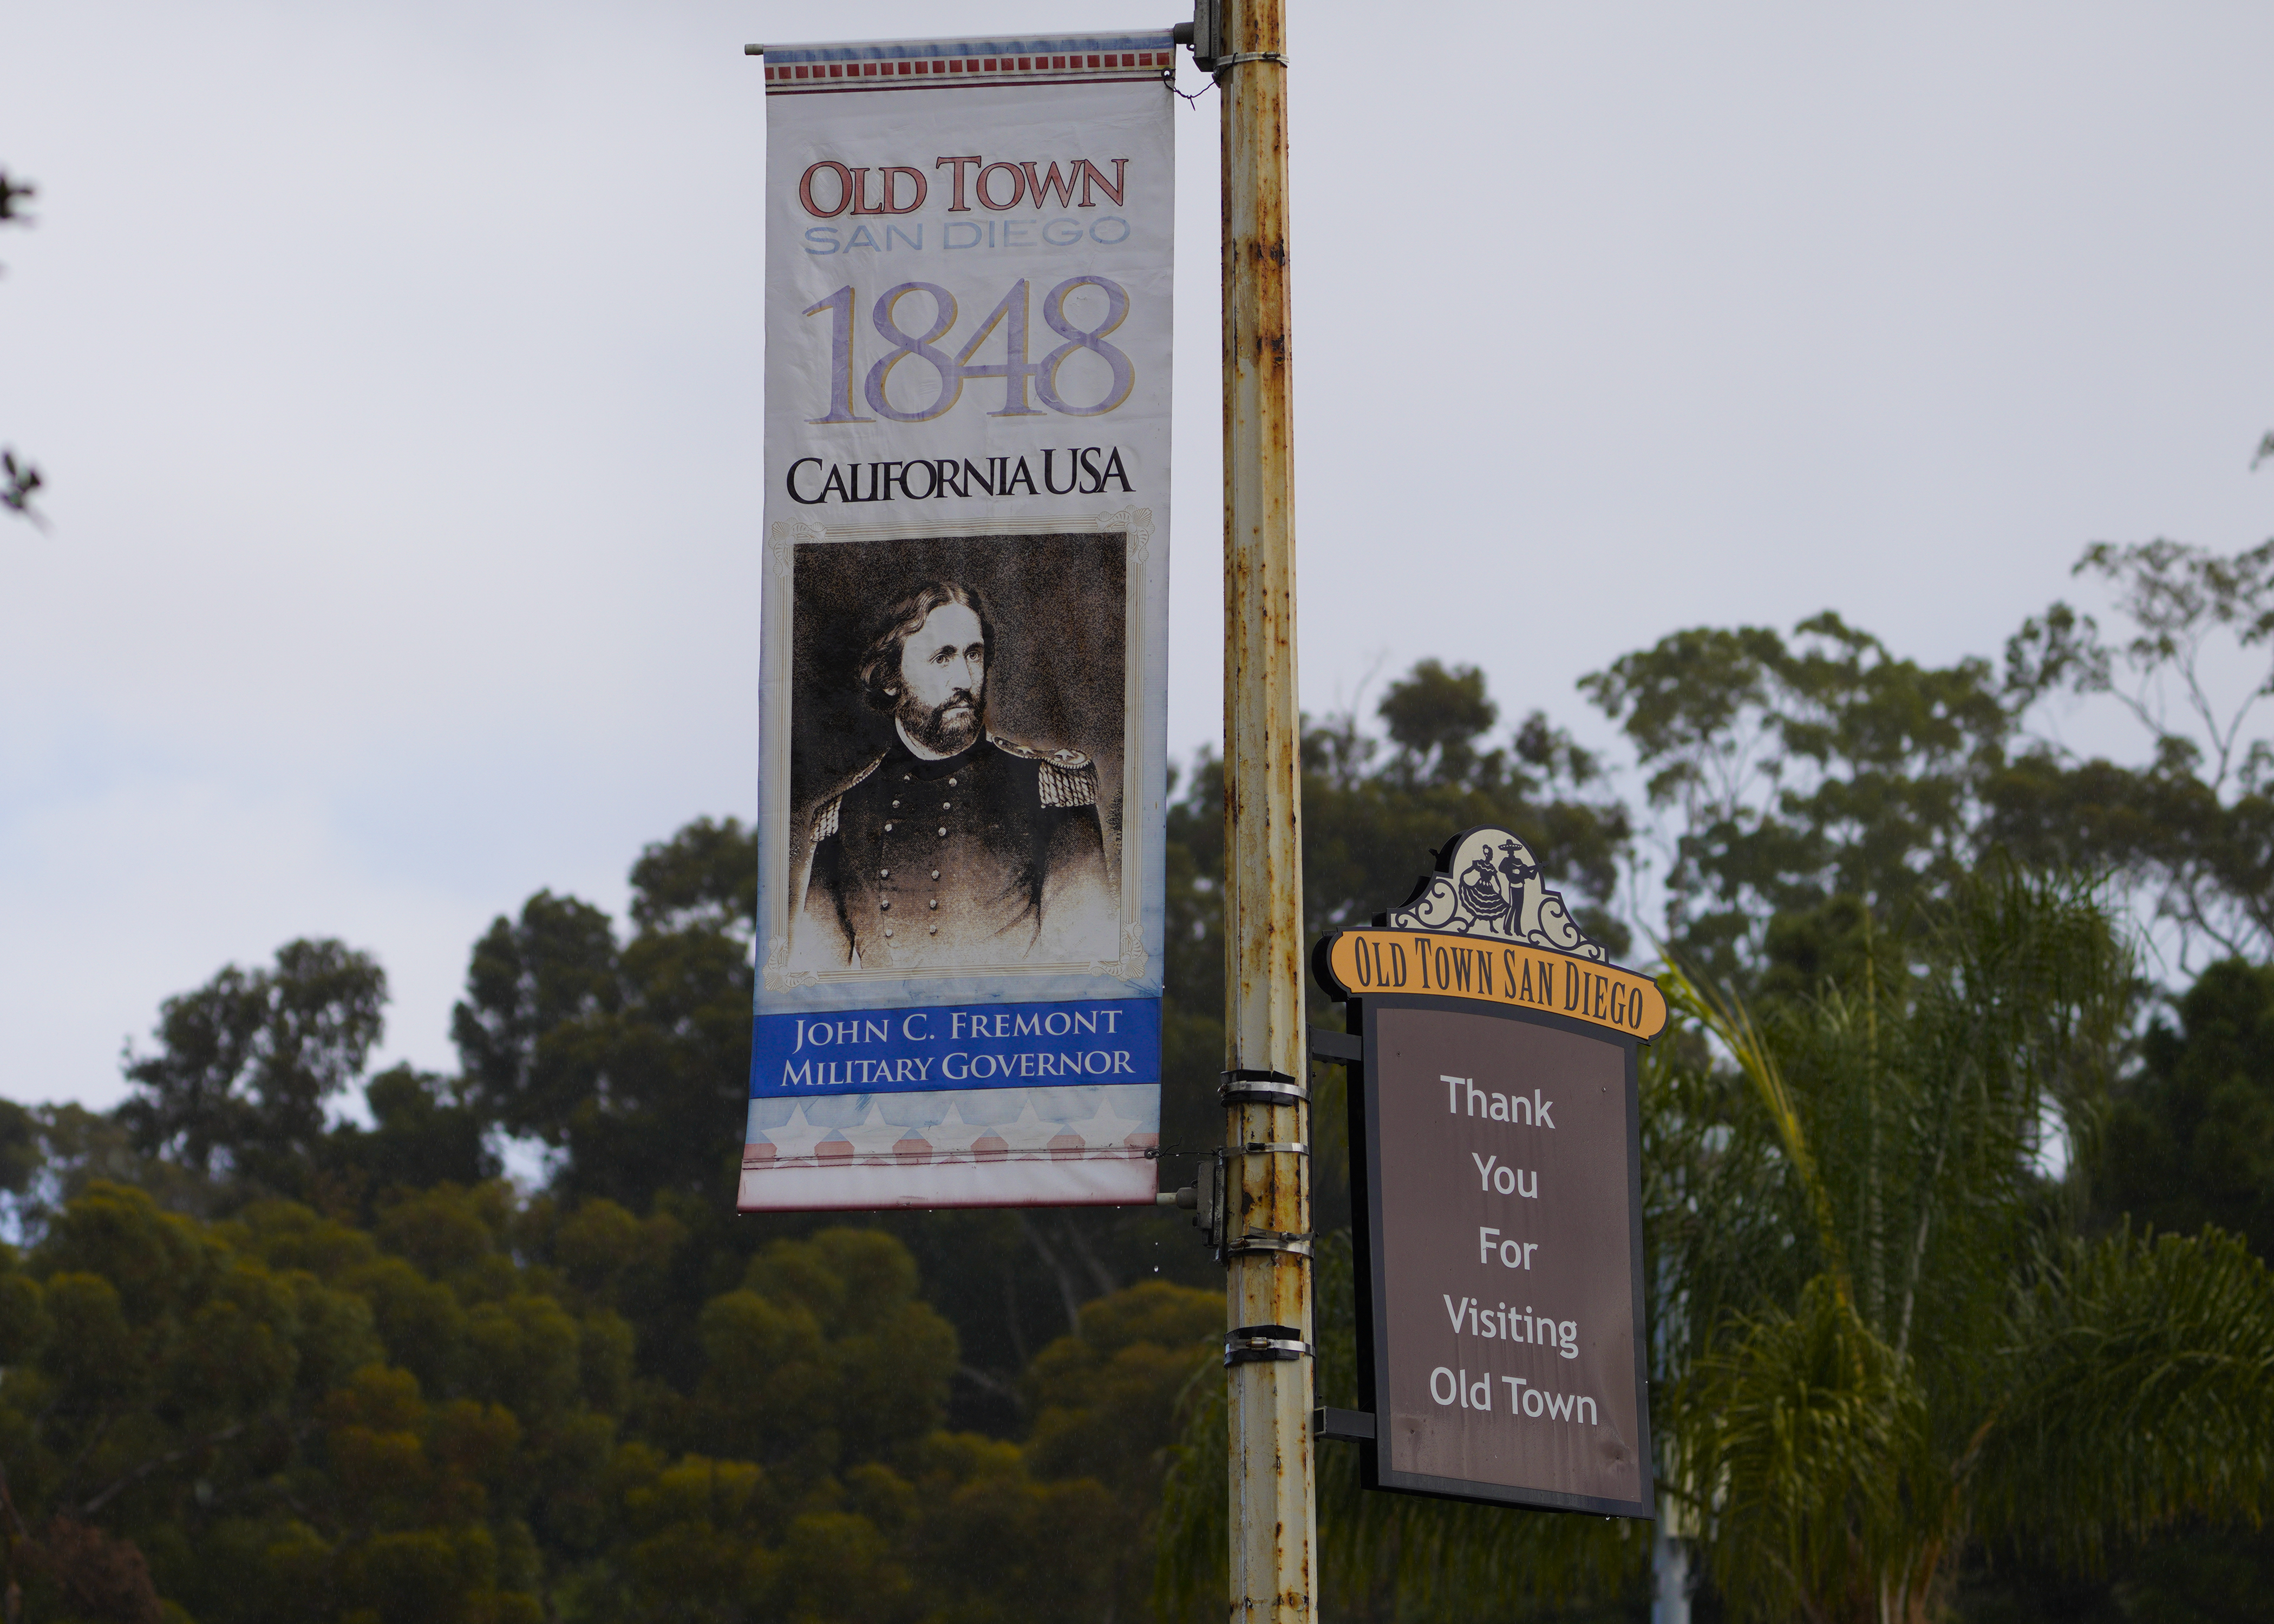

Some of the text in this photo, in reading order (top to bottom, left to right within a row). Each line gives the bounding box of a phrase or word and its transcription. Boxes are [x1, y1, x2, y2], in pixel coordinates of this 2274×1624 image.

[799, 155, 1129, 218] OLD TOWN
[803, 216, 1131, 255] SAN DIEGO
[802, 275, 1135, 424] 1848
[787, 446, 1136, 505] CALIFORNIA USA
[1354, 936, 1643, 1030] OLD TOWN SAN DIEGO
[792, 1010, 1123, 1055] JOHN C. FREMONT
[780, 1051, 1136, 1086] MILITARY GOVERNOR
[1440, 1075, 1556, 1129] Thank
[1472, 1152, 1539, 1199] You
[1479, 1226, 1539, 1271] For
[1443, 1294, 1579, 1359] Visiting
[1429, 1366, 1598, 1426] Old Town
